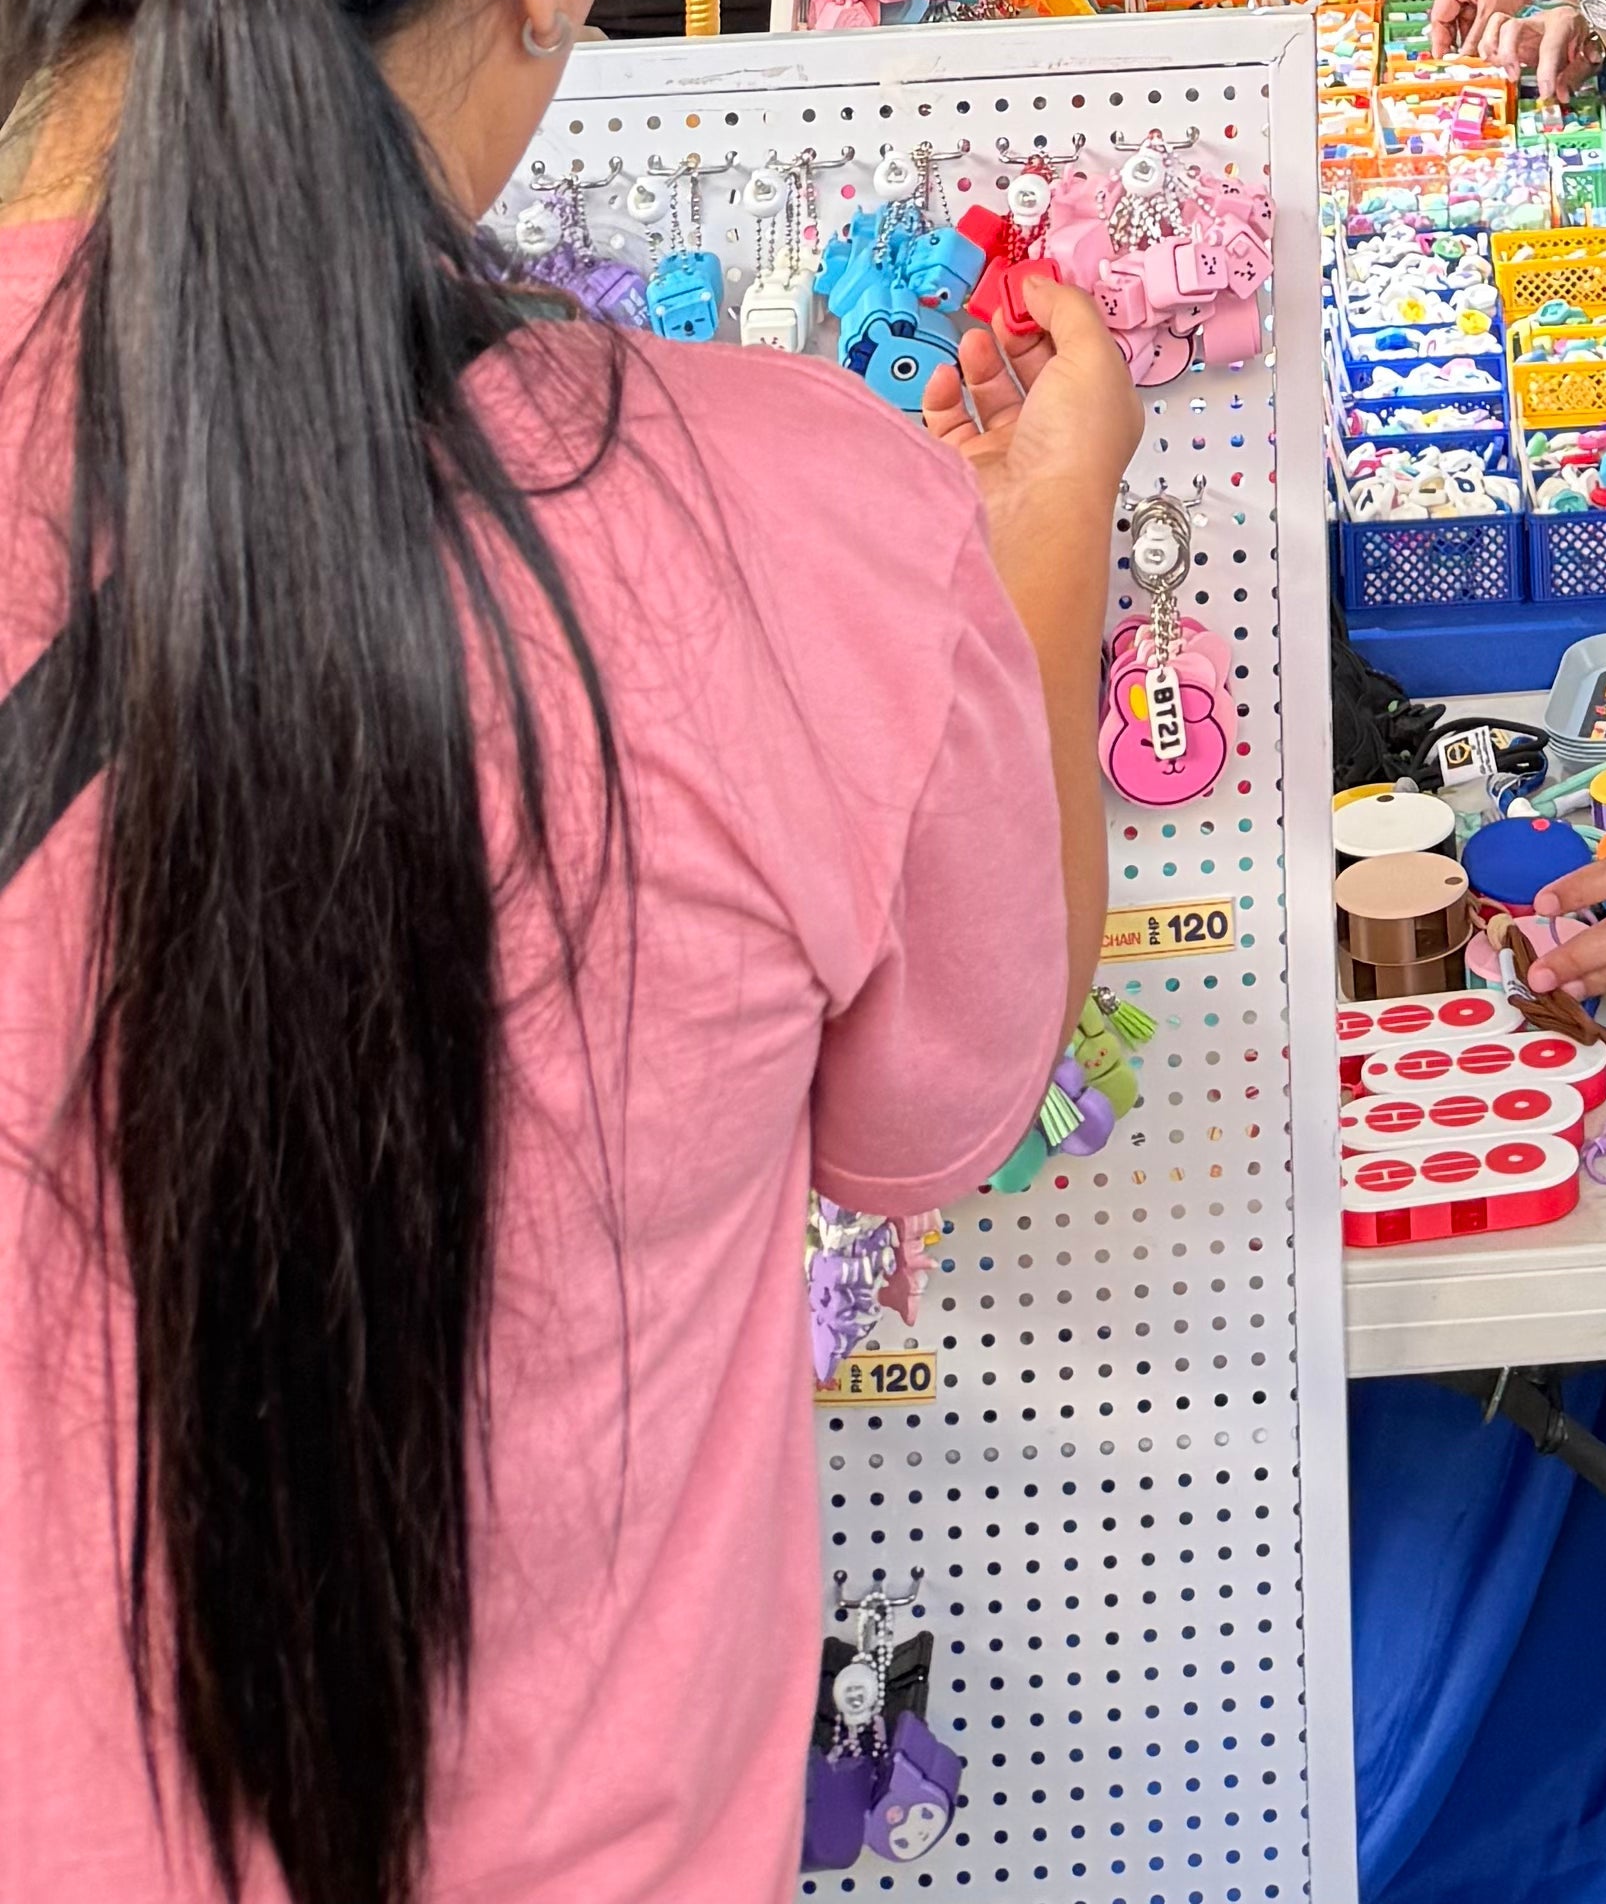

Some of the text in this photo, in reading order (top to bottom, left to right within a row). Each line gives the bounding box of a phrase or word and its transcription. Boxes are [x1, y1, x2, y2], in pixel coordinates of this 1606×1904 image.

[1154, 686, 1181, 751] BT21
[1101, 910, 1229, 948] CHAIN PHP 120
[851, 1364, 863, 1393] PHP
[870, 1362, 932, 1392] 120
